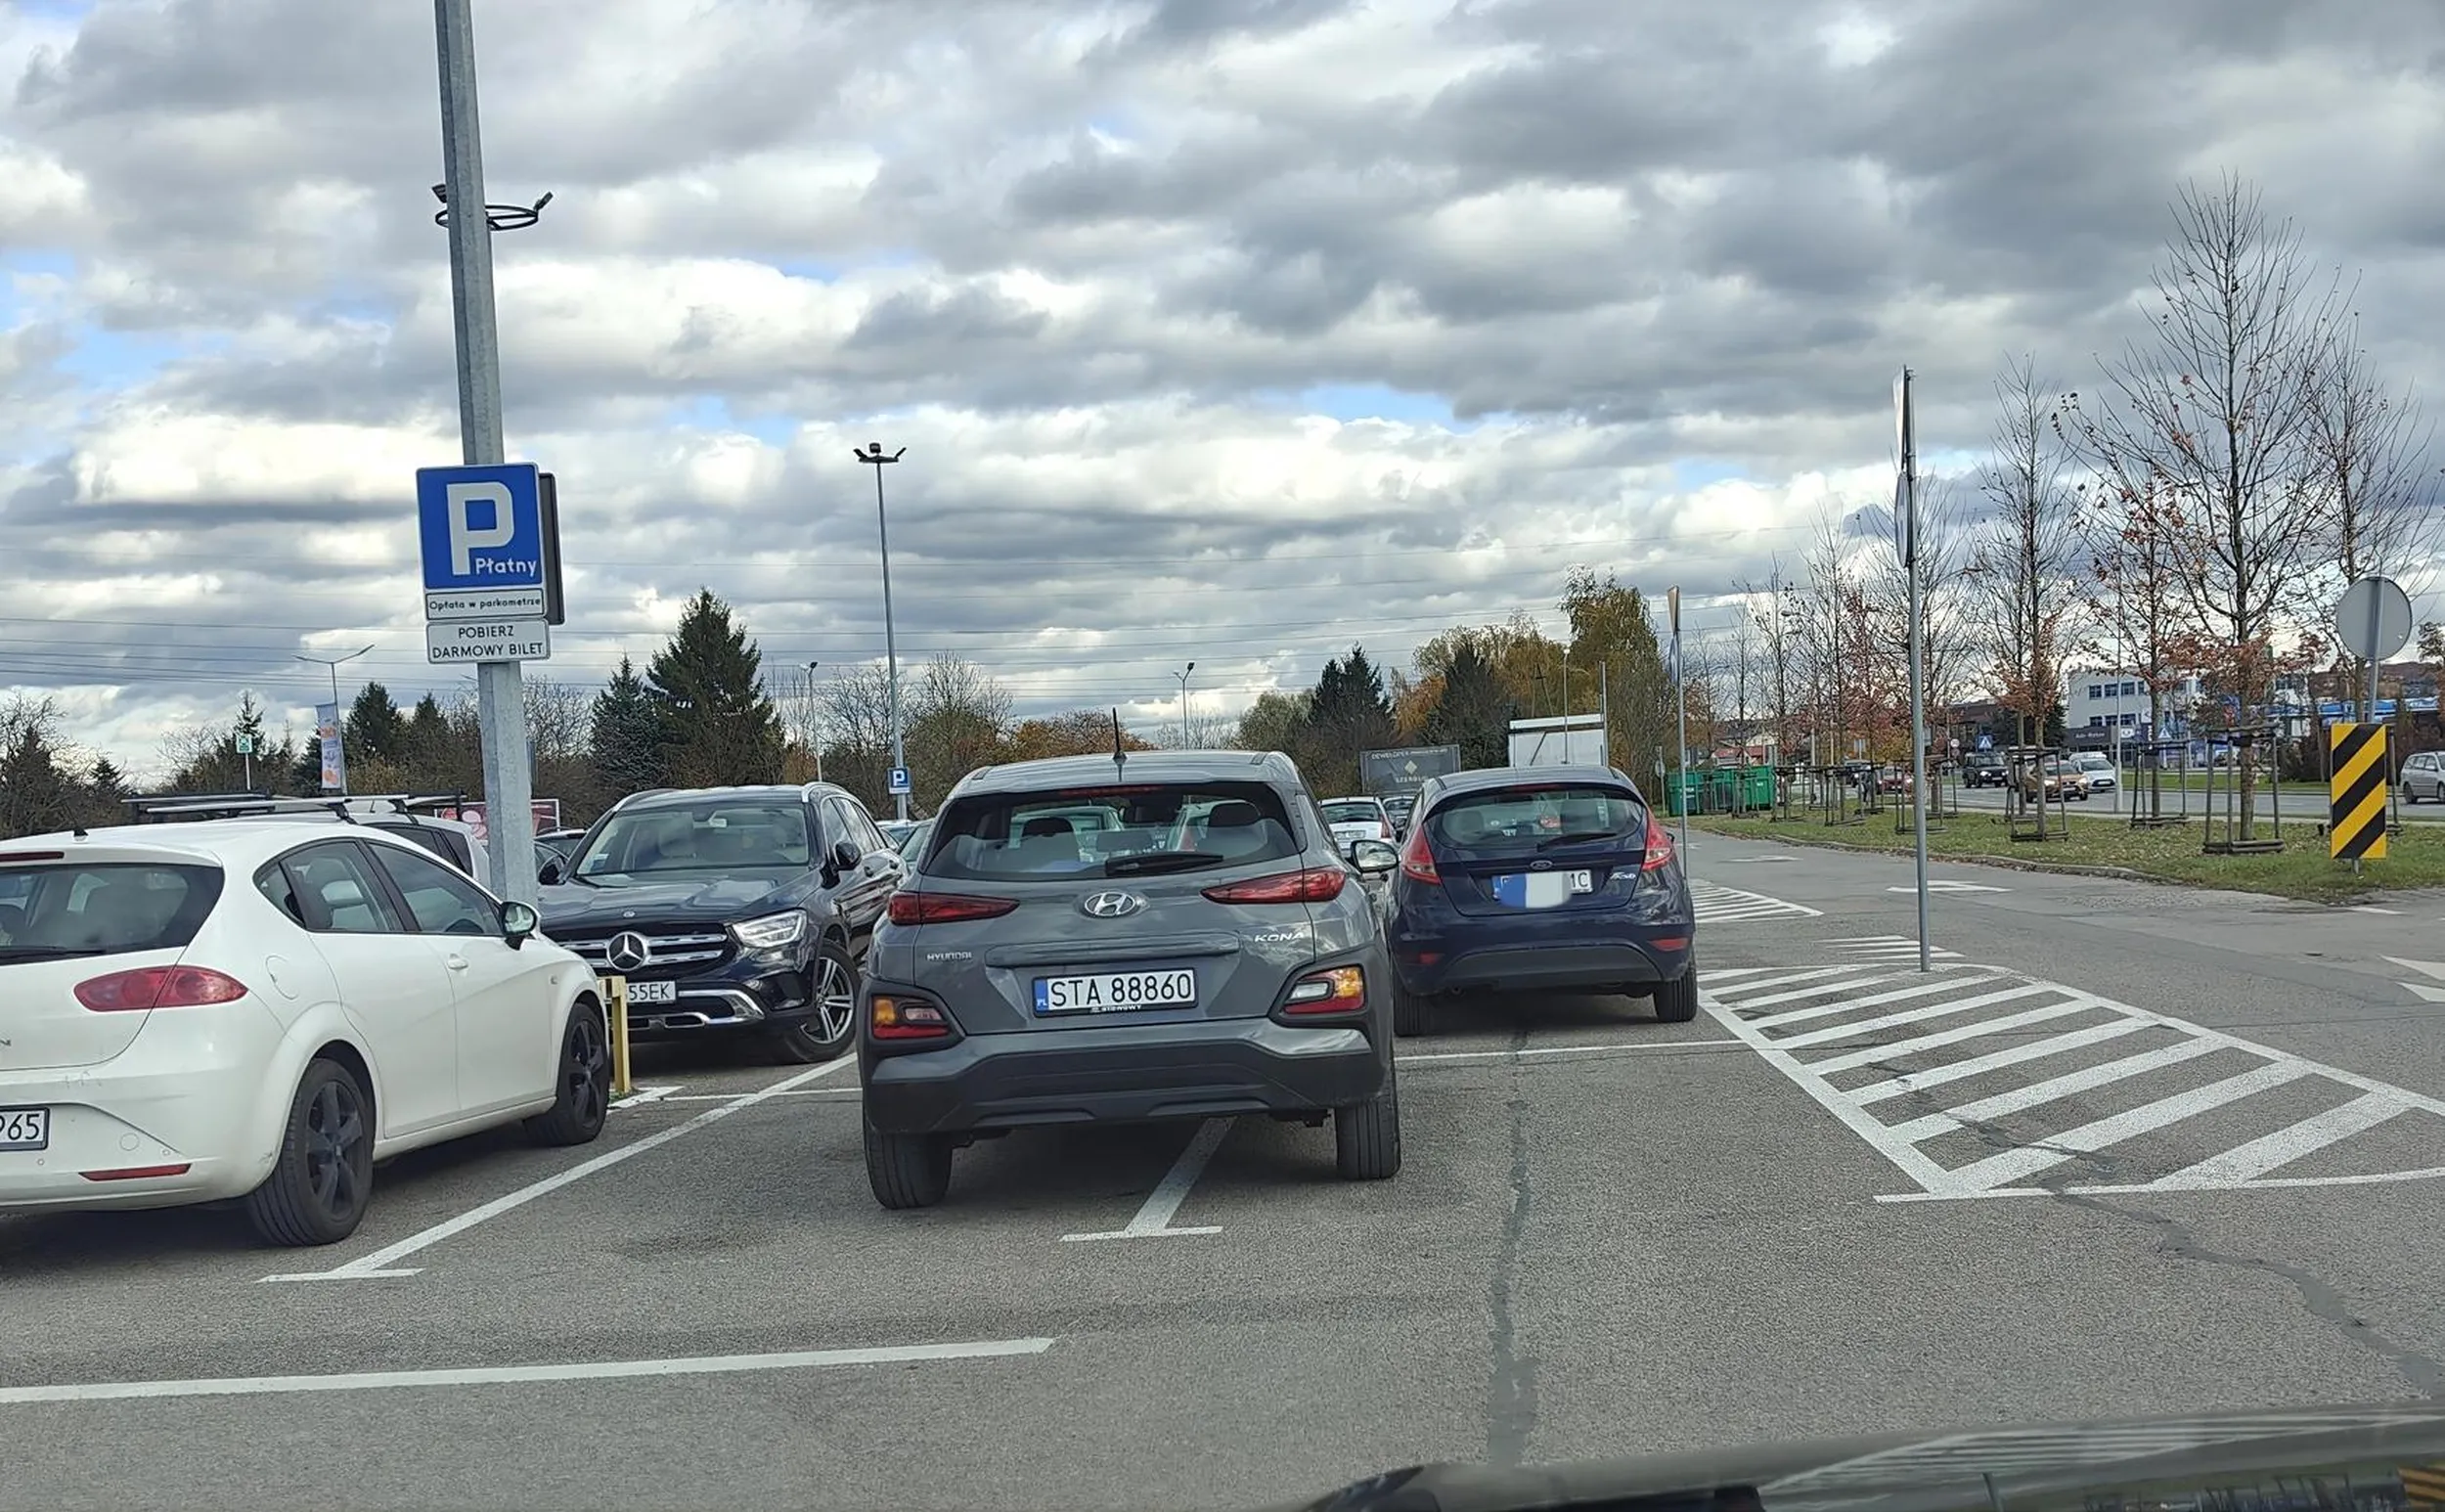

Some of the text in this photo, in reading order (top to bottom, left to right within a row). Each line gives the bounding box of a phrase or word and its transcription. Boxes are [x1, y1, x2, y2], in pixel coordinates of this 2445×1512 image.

[446, 481, 514, 575] P
[475, 557, 537, 577] Płatny
[429, 600, 465, 611] Opłata
[479, 598, 541, 609] parkometrze
[458, 625, 514, 639] POBIERZ
[432, 642, 543, 659] DARMOWY BILET
[893, 770, 906, 786] P
[1254, 931, 1304, 942] KONA
[926, 951, 972, 960] HYUNDAI
[628, 983, 670, 1001] 55EK
[1050, 973, 1191, 1007] STA 88860
